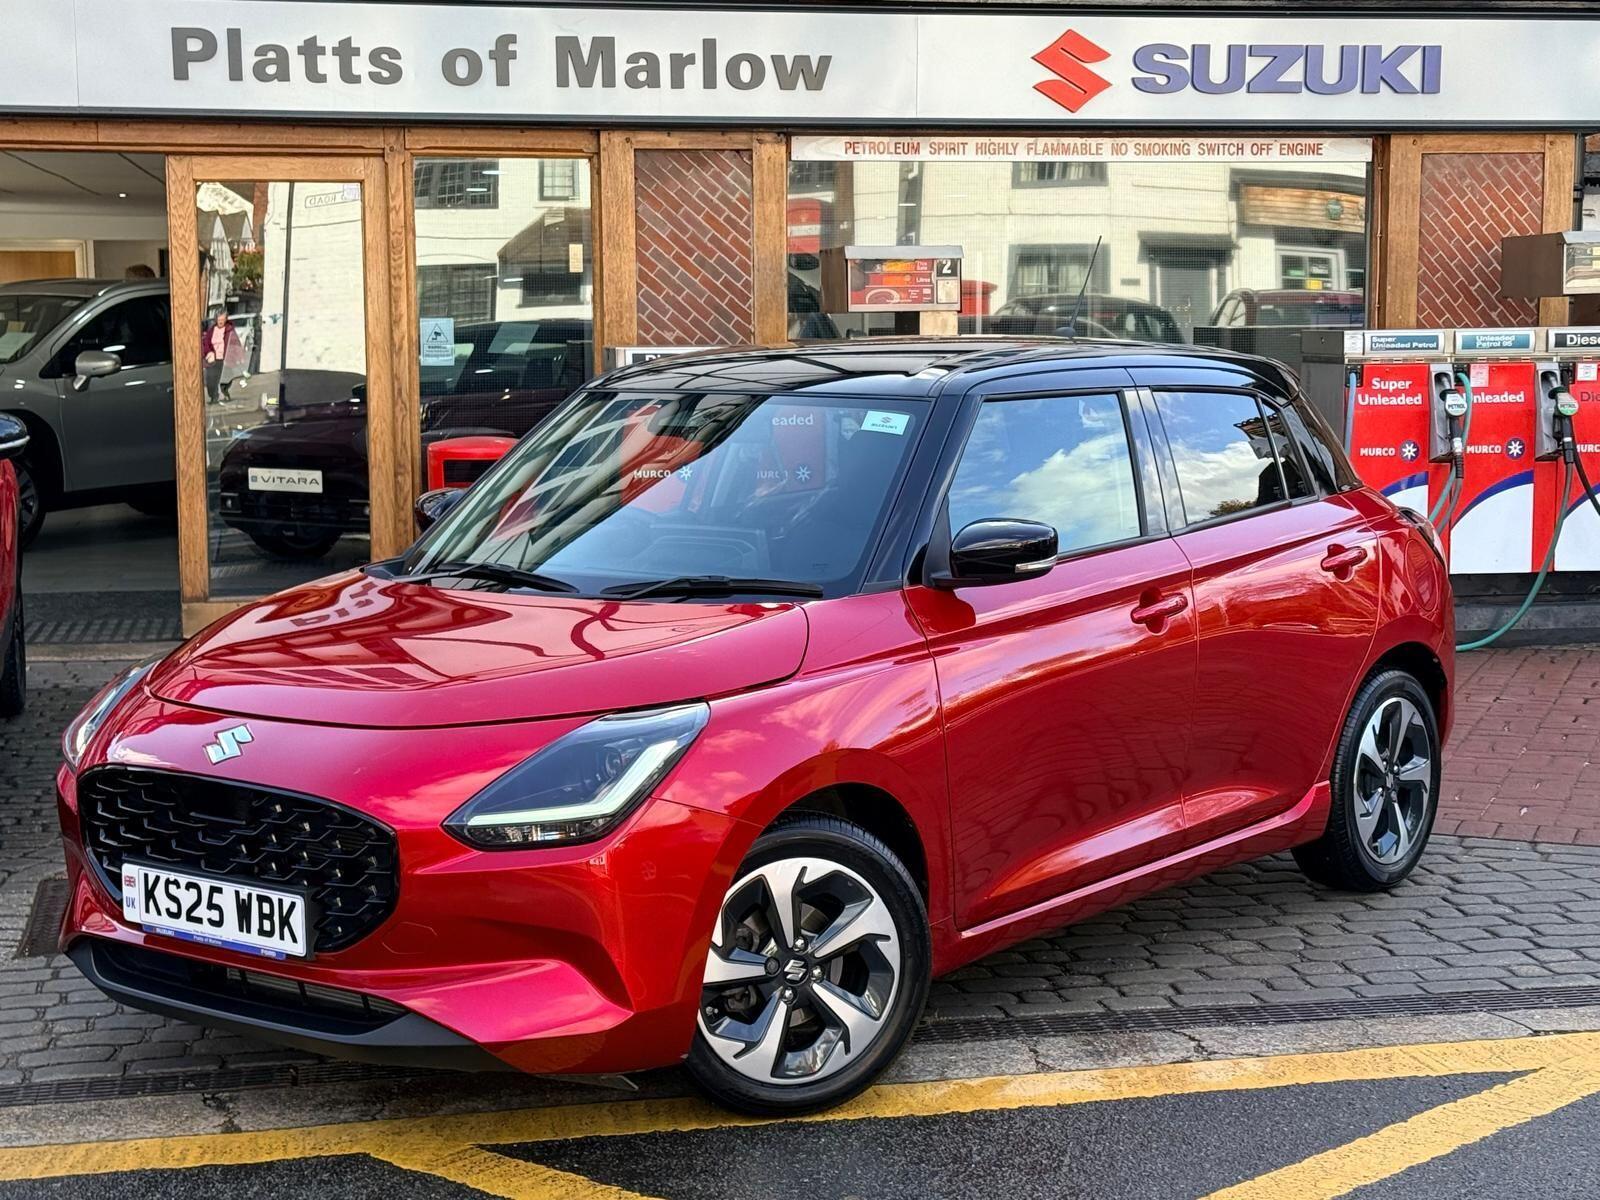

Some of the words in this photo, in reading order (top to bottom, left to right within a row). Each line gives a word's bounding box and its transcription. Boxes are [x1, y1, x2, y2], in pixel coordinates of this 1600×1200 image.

[171, 27, 403, 85] Platts
[441, 34, 518, 87] of
[555, 35, 832, 91] Marlow
[1131, 43, 1442, 95] SUZUKI
[844, 141, 921, 155] PETROLEUM
[929, 141, 968, 156] SPIRIT
[975, 142, 1019, 156] HIGHLY
[1027, 142, 1103, 156] FLAMMABLE
[1111, 142, 1128, 156] NO
[1134, 142, 1191, 156] SMOKING
[1198, 143, 1244, 156] SWITCH
[1251, 143, 1273, 156] OFF
[1279, 143, 1323, 156] ENGINE
[942, 258, 952, 274] 2
[1371, 377, 1412, 391] Super
[1358, 394, 1423, 405] Unleaded
[771, 414, 814, 426] eaded
[1360, 447, 1396, 457] MURCO
[1466, 445, 1502, 454] MURCO
[261, 475, 320, 486] VITARA
[633, 470, 671, 479] MURCO
[126, 895, 136, 910] UK
[143, 872, 225, 929] KS25
[234, 889, 298, 945] WBK
